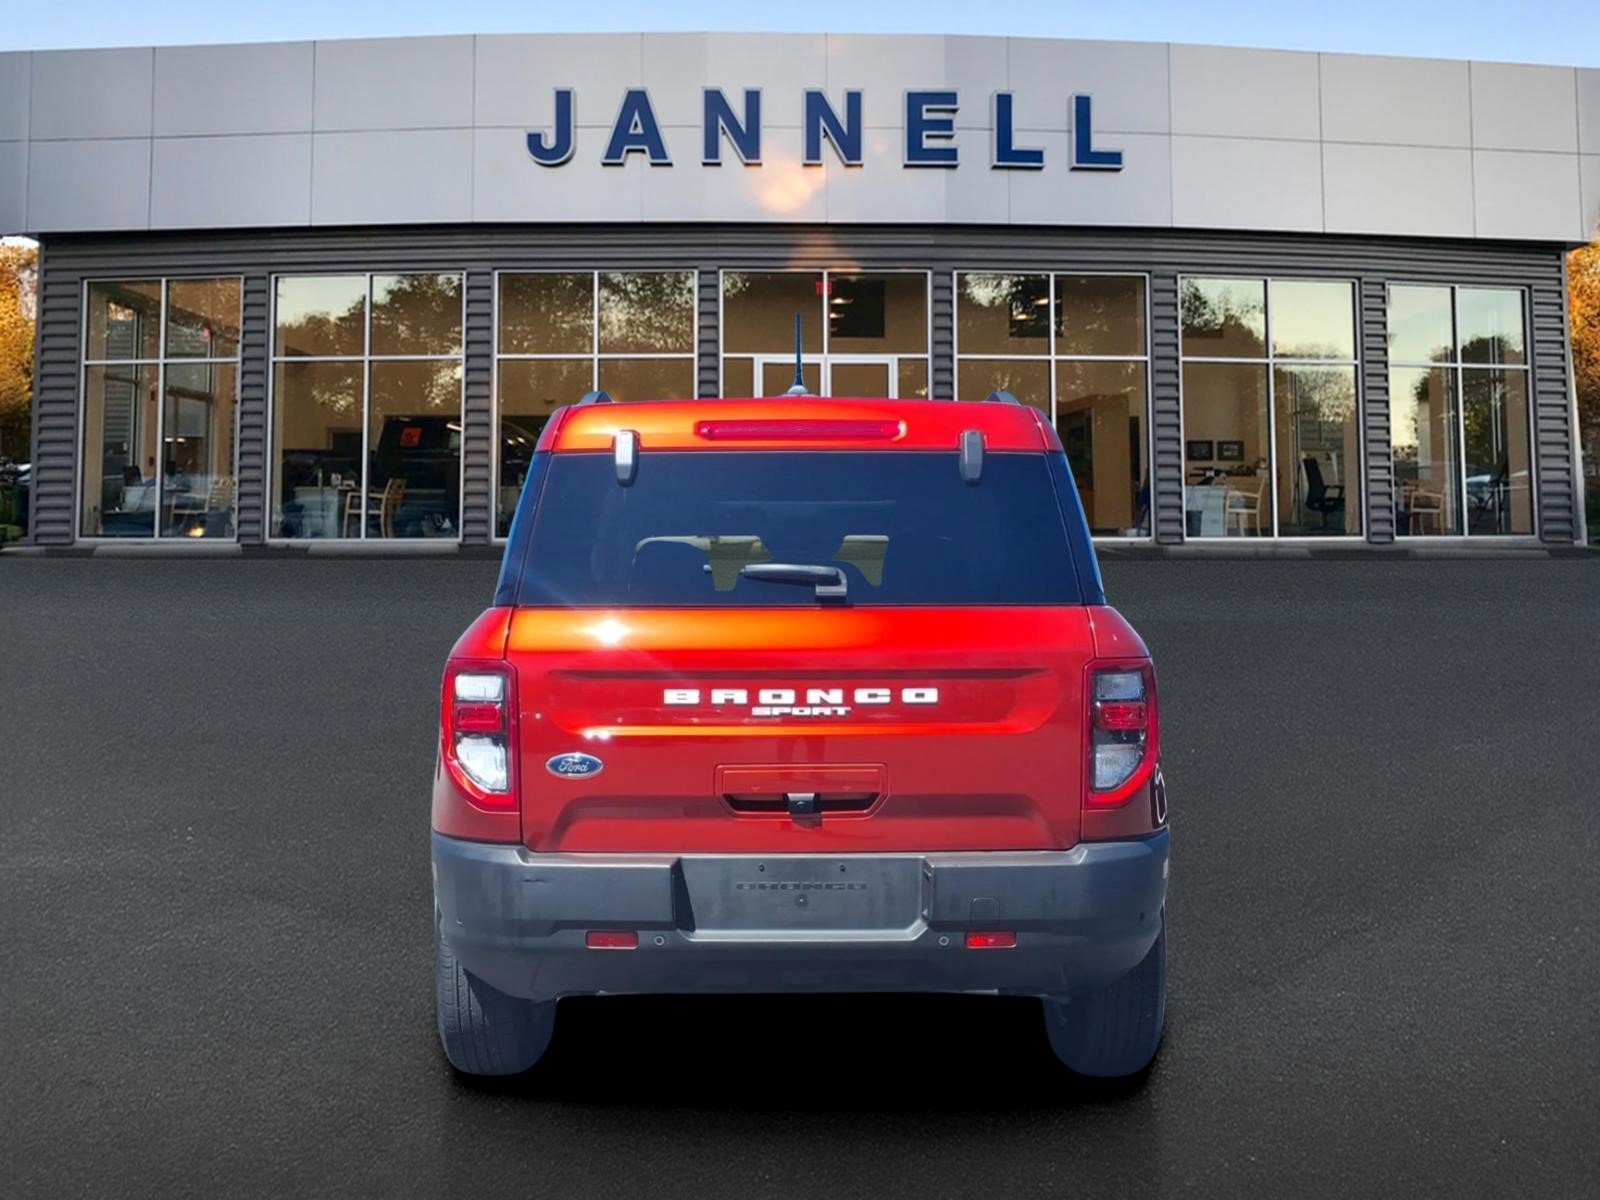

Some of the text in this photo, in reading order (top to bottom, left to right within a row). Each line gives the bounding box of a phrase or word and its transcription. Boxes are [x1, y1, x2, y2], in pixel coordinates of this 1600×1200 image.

[526, 87, 1124, 171] JANNELL
[664, 688, 938, 705] BRONCO
[751, 706, 852, 717] SPORT
[558, 757, 590, 772] Ford
